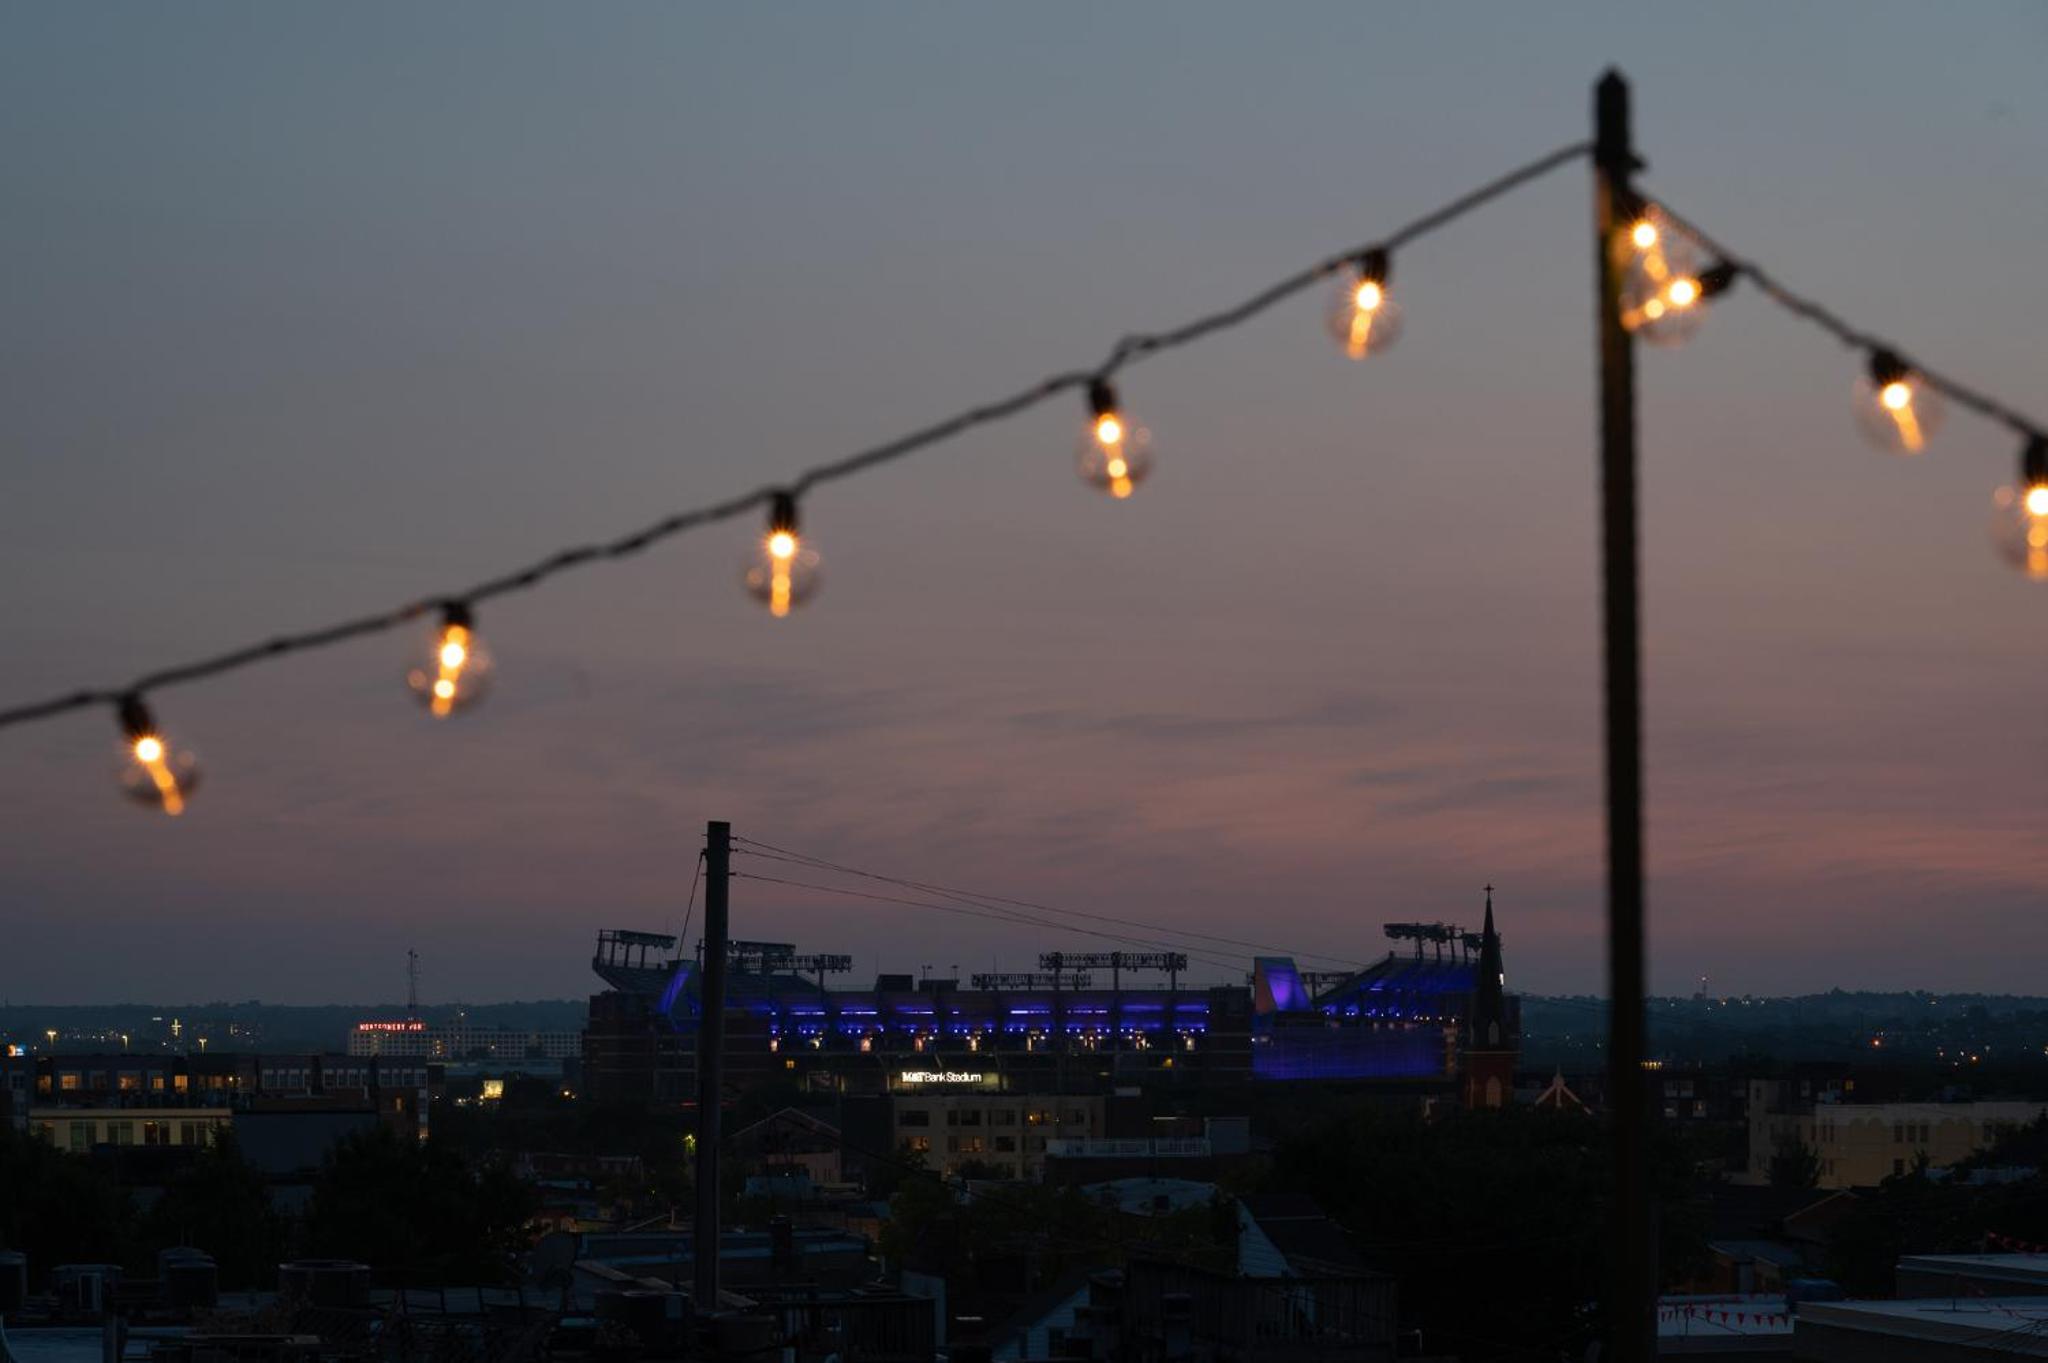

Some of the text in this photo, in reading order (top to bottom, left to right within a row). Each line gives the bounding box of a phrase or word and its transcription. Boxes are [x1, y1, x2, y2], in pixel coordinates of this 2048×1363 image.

[902, 1071, 982, 1082] M&T Bank Stadium
